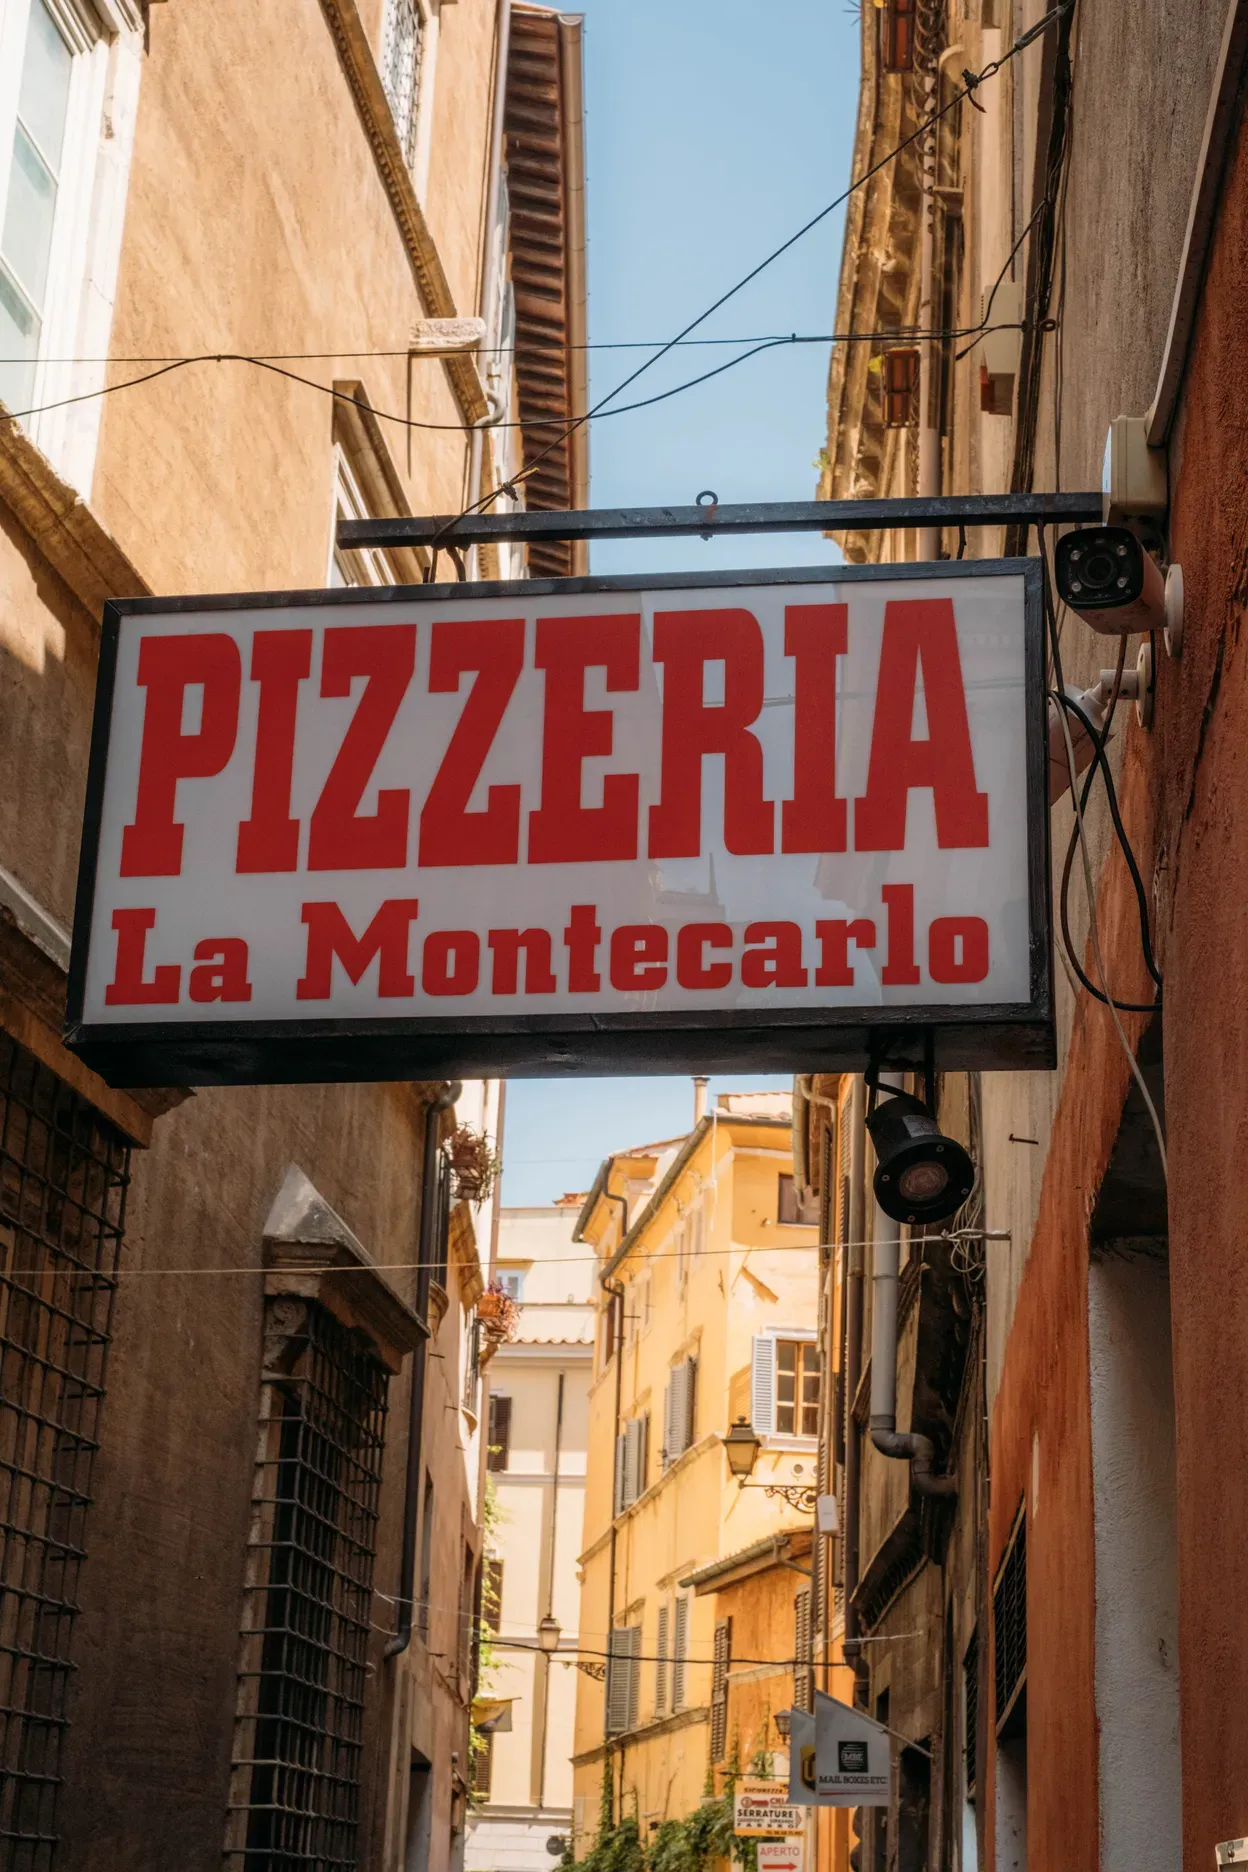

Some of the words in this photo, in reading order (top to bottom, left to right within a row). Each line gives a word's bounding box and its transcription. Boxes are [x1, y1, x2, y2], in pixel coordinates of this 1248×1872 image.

[120, 599, 988, 877] PIZZERIA
[106, 908, 251, 1005] La
[297, 884, 988, 999] Montecarlo
[819, 1776, 842, 1784] MAIL
[844, 1776, 869, 1785] BOXES
[737, 1809, 794, 1818] SERRATURE
[760, 1847, 800, 1856] APERTO
